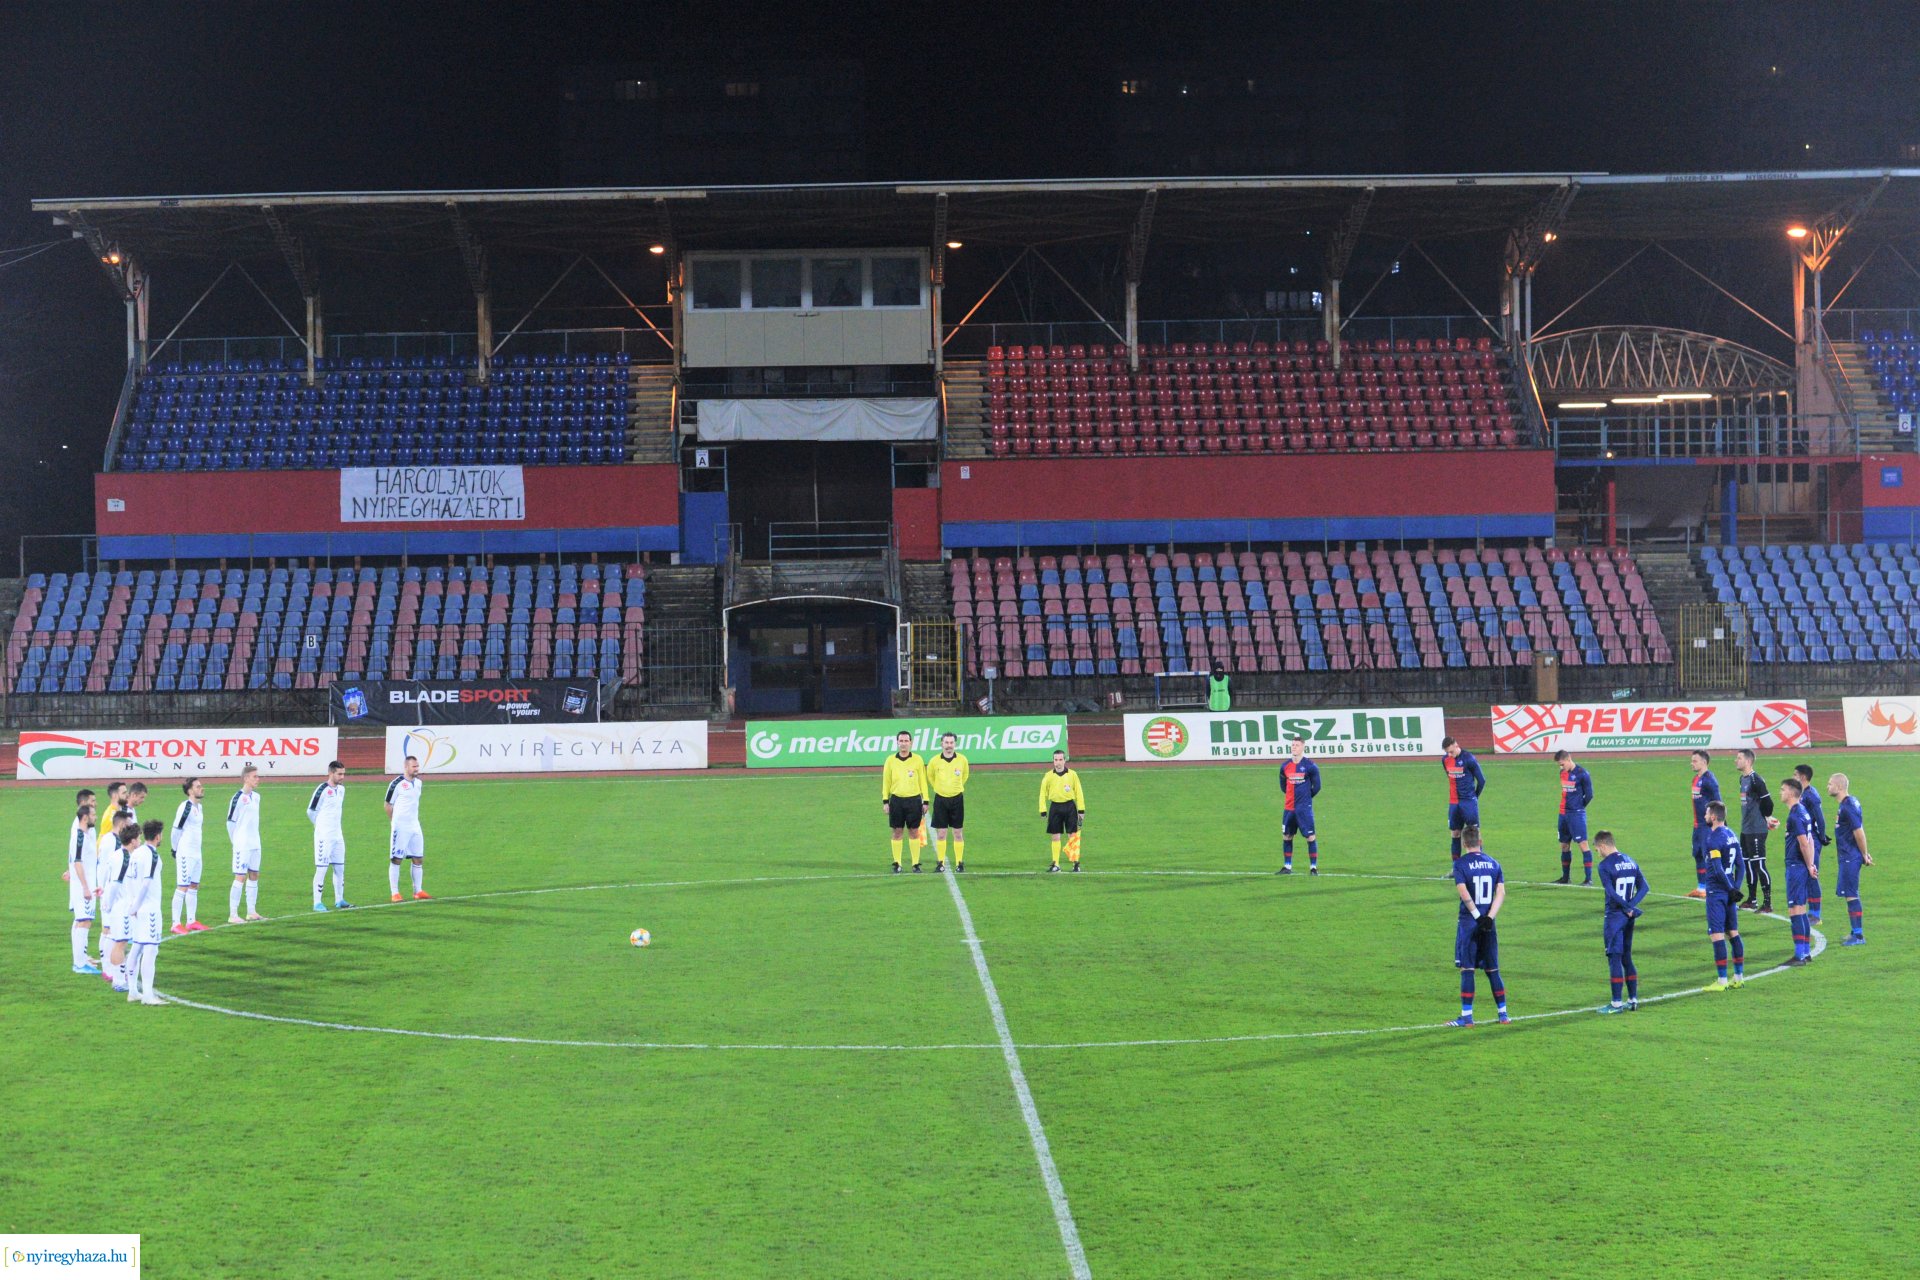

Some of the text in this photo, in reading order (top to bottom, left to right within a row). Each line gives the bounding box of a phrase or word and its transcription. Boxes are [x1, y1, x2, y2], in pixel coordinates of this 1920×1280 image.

[699, 456, 706, 465] A
[375, 468, 505, 496] HARCOLJATOK
[308, 635, 315, 647] B
[389, 688, 531, 703] BLADESPORT
[506, 702, 532, 711] power
[516, 708, 541, 717] yours!
[1209, 712, 1423, 743] mlsz.hu
[84, 737, 320, 759] LERTON TRANS
[479, 737, 684, 757] NYÍREGYHÁZA
[789, 726, 1056, 753] merkanilbank LIGA
[1211, 742, 1424, 757] Magyar Labarúgó Szövetség
[1590, 738, 1625, 746] ALWAYS
[1642, 737, 1658, 745] THE
[1660, 737, 1687, 745] RIGHT
[1688, 736, 1709, 744] WAY
[1725, 847, 1737, 874] 3
[1472, 875, 1493, 904] 10
[1615, 876, 1635, 901] 97
